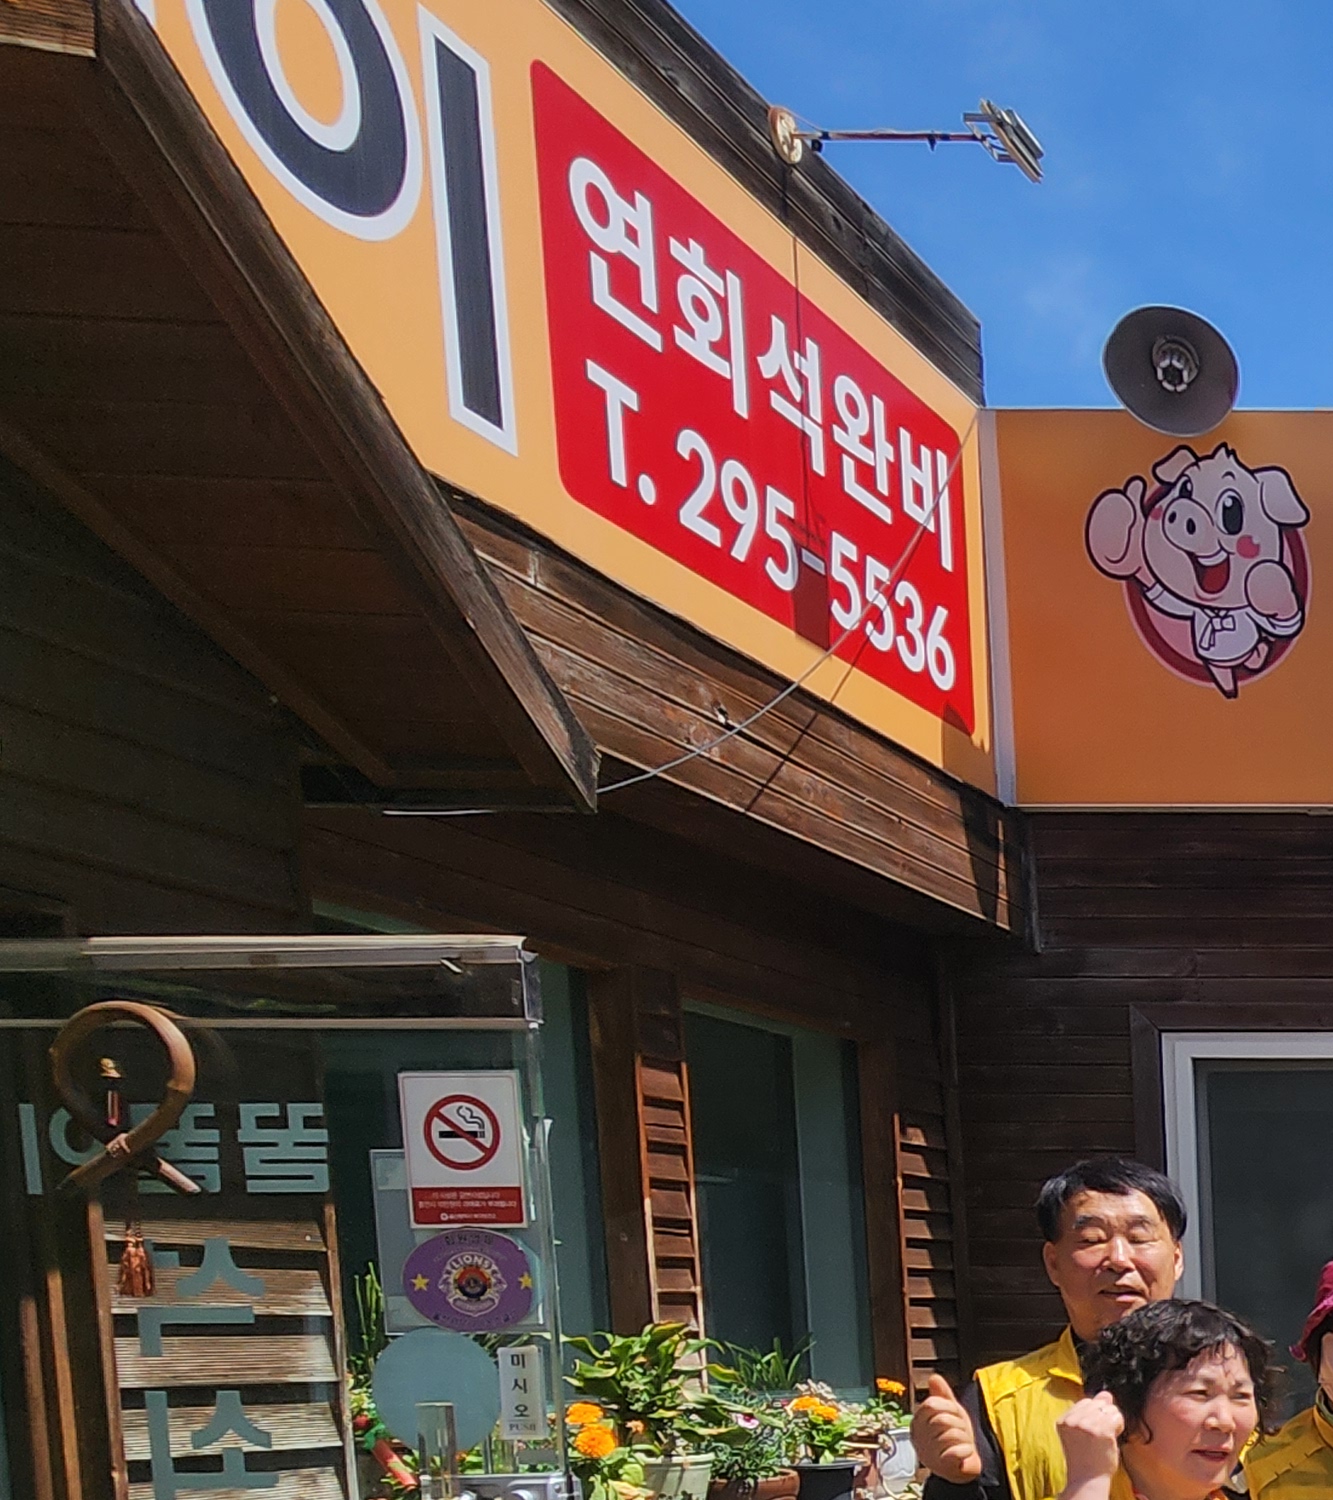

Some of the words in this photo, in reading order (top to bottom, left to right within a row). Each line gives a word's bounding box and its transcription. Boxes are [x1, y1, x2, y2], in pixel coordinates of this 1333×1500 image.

[568, 156, 953, 572] 연회석완비
[584, 359, 658, 505] T.
[677, 427, 956, 691] 295-5536
[451, 1255, 491, 1269] LIONS
[511, 1354, 530, 1418] 미시오
[509, 1423, 536, 1431] PUSH
